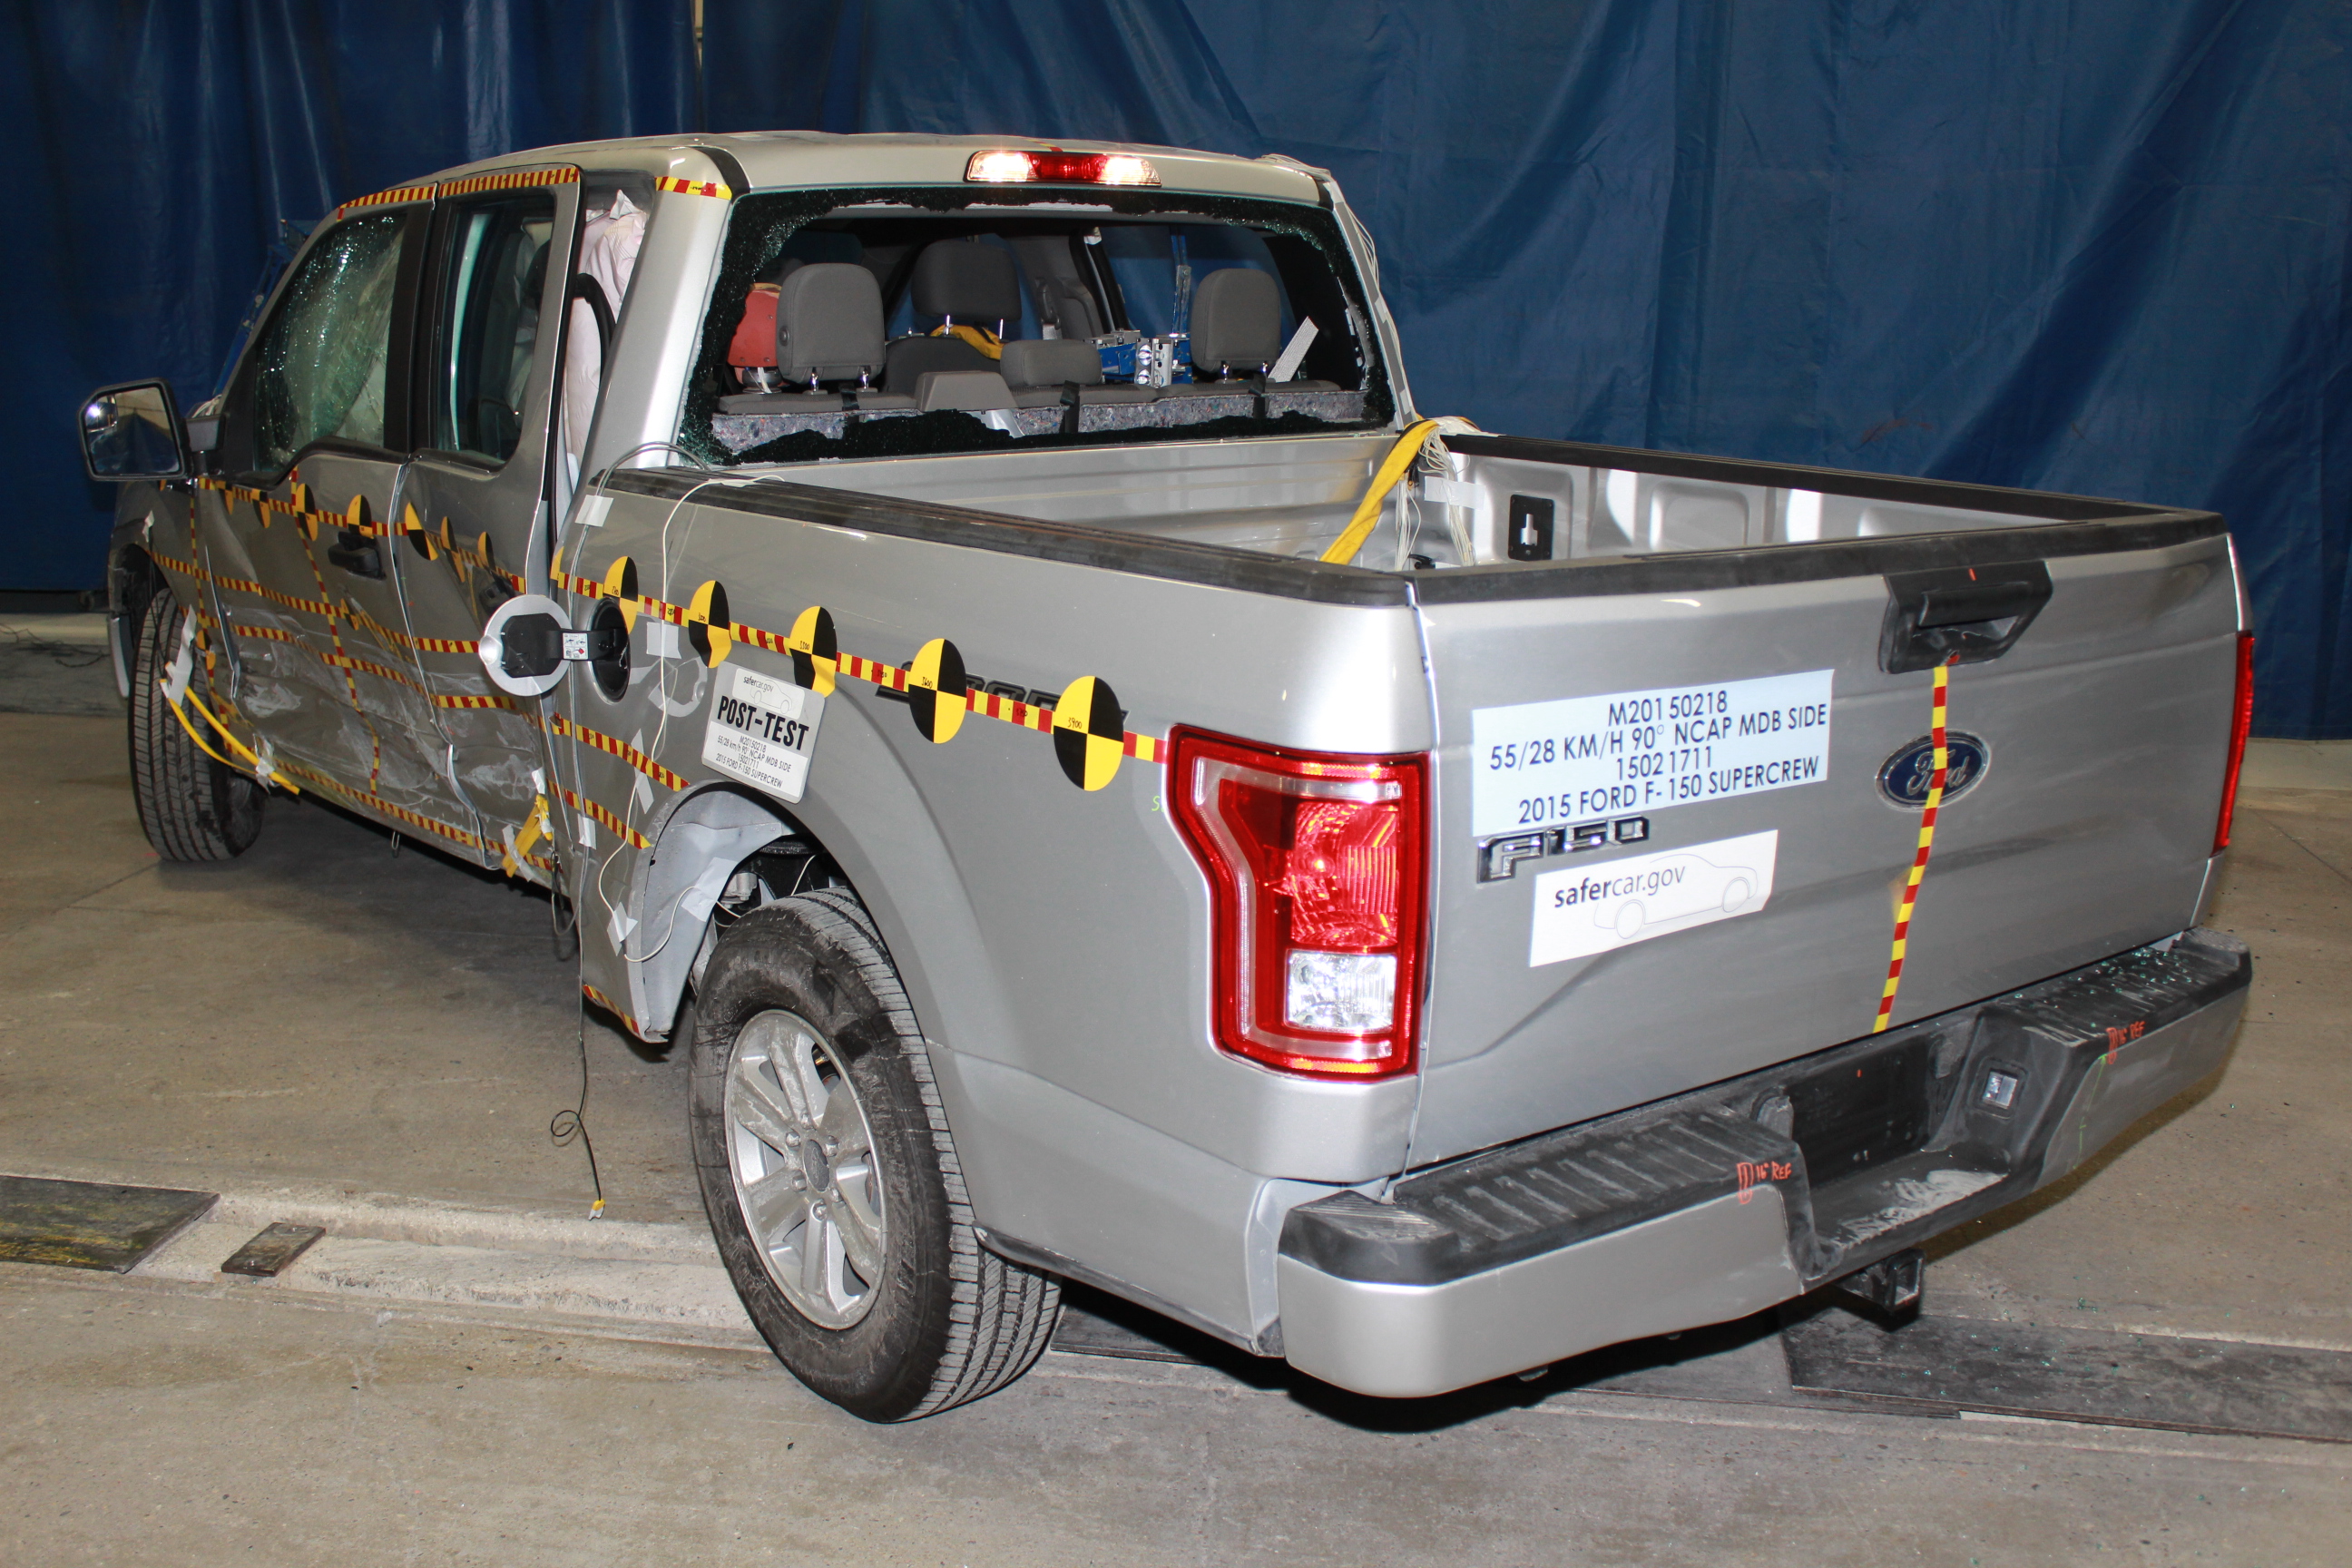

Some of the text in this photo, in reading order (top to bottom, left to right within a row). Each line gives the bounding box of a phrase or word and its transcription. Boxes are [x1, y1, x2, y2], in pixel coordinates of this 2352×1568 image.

[743, 676, 774, 692] safercar.gov
[717, 695, 809, 750] POST-TEST
[1067, 717, 1083, 730] 3900
[1608, 690, 1728, 727] M20150218
[740, 735, 767, 753] M20150218
[1490, 739, 1555, 771] 55/28
[1564, 730, 1623, 760] KM/H
[1675, 716, 1732, 746] NCAP
[1739, 710, 1781, 737] MDB
[1788, 703, 1828, 730] SIDE
[716, 753, 783, 788] 2015 FORD F-150 SUPERCREW
[750, 750, 765, 762] NCAP
[766, 755, 779, 768] MDB
[779, 760, 791, 773] SIDE
[1518, 755, 1819, 824] 2015 FORD F-150 SUPERCREW
[1553, 866, 1686, 908] safercar.gov
[1771, 1160, 1792, 1181] REF
